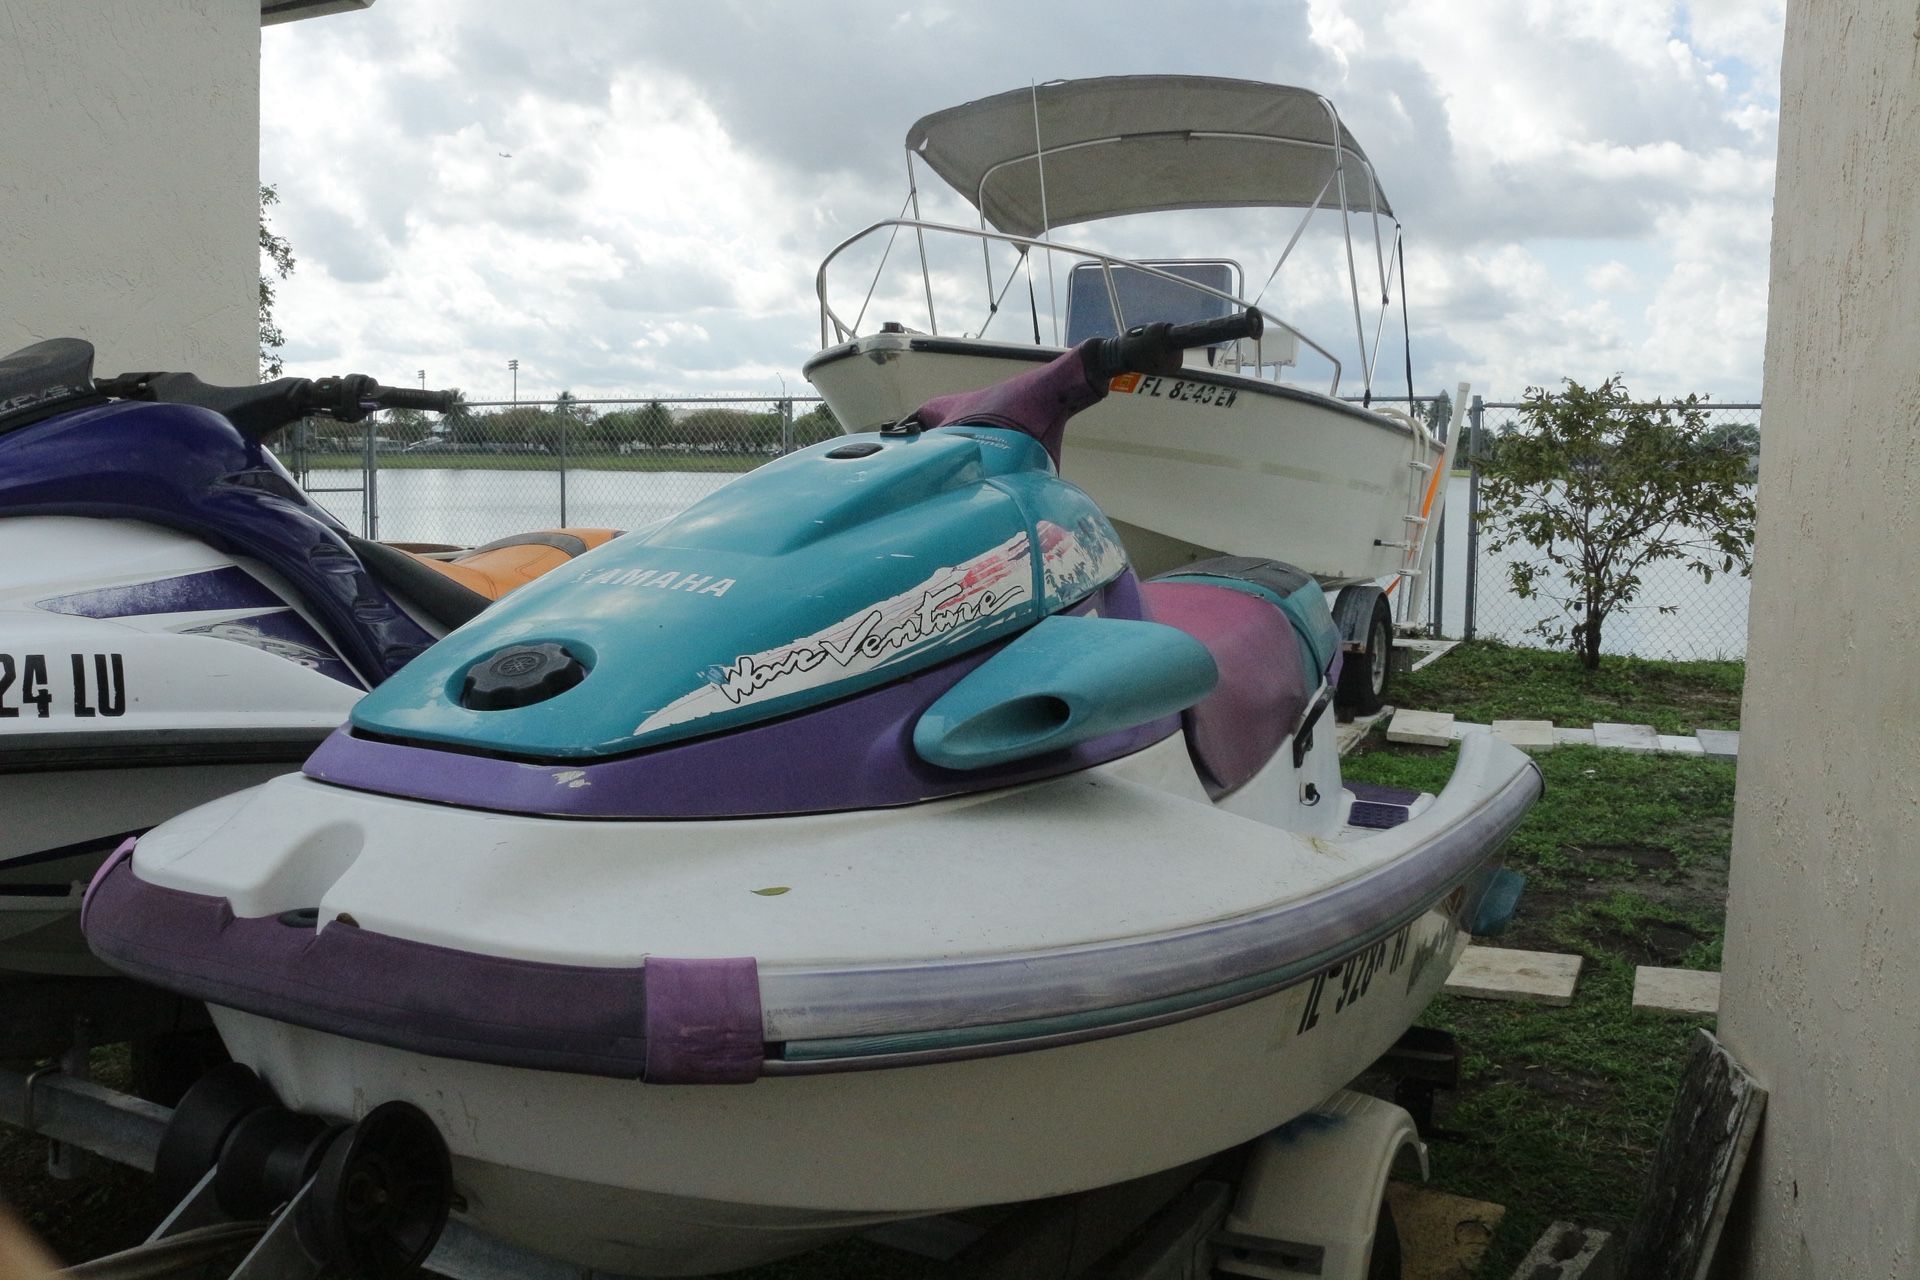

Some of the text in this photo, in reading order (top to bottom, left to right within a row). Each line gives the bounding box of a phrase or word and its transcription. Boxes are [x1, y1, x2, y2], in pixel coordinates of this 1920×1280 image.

[1138, 376, 1162, 396] FL
[720, 582, 1025, 704] Wave Venture
[0, 653, 126, 718] 24 LU
